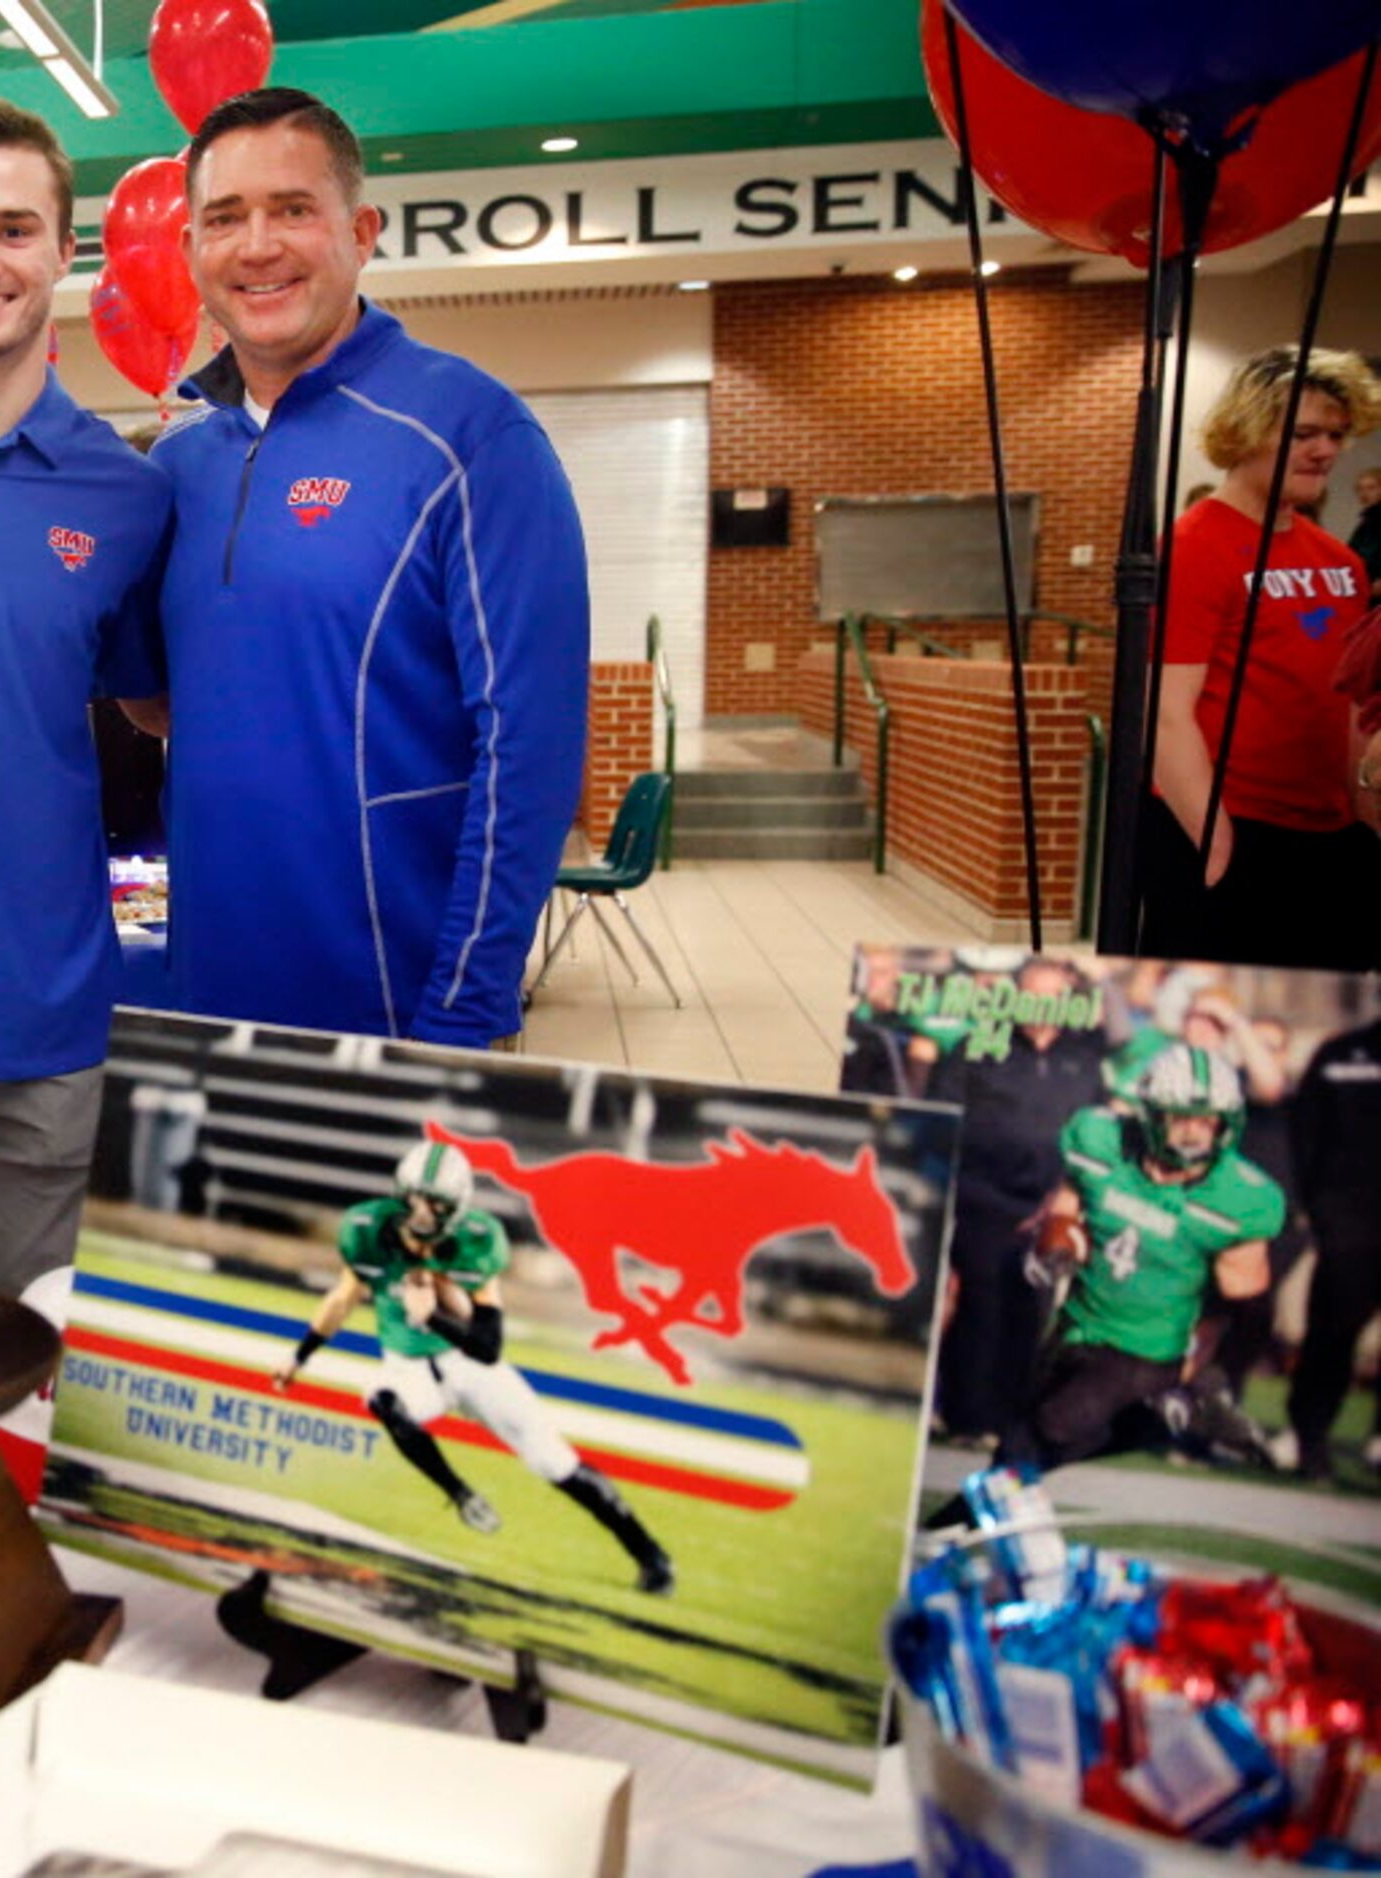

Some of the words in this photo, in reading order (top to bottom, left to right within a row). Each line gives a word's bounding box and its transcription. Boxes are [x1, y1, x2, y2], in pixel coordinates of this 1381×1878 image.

[287, 478, 351, 506] SMU
[48, 526, 96, 557] SMU
[897, 971, 936, 1018] TJ
[938, 972, 1103, 1031] McDaniel
[62, 1356, 197, 1413] SOUTHERN
[211, 1393, 383, 1458] METHODIST
[126, 1405, 294, 1474] UNIVERSITY
